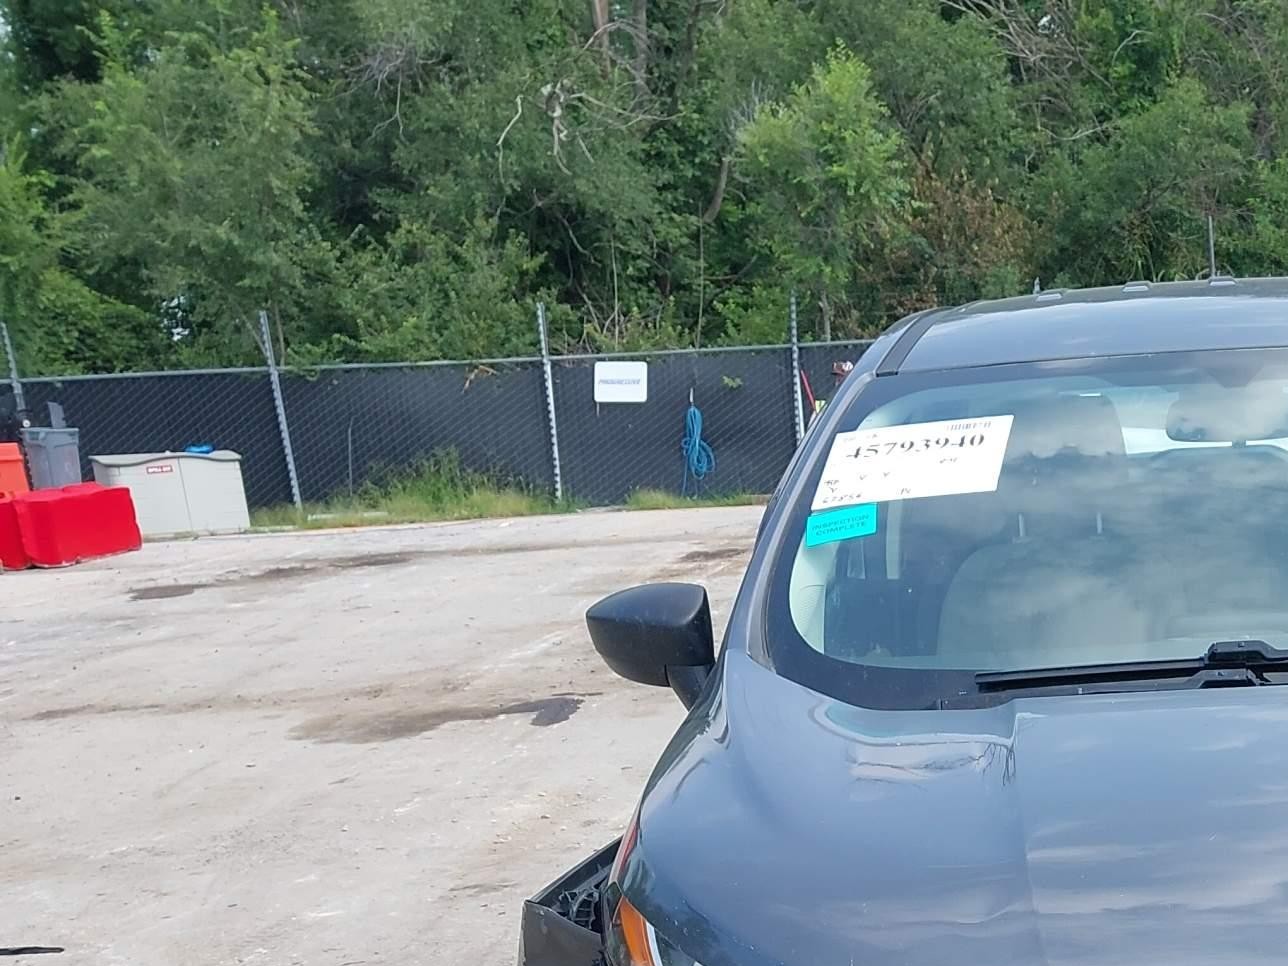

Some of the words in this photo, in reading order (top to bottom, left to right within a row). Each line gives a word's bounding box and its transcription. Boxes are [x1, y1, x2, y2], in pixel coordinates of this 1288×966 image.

[846, 433, 985, 459] 45793940
[812, 514, 869, 531] INSPECTION
[816, 522, 866, 536] COMPLETE
